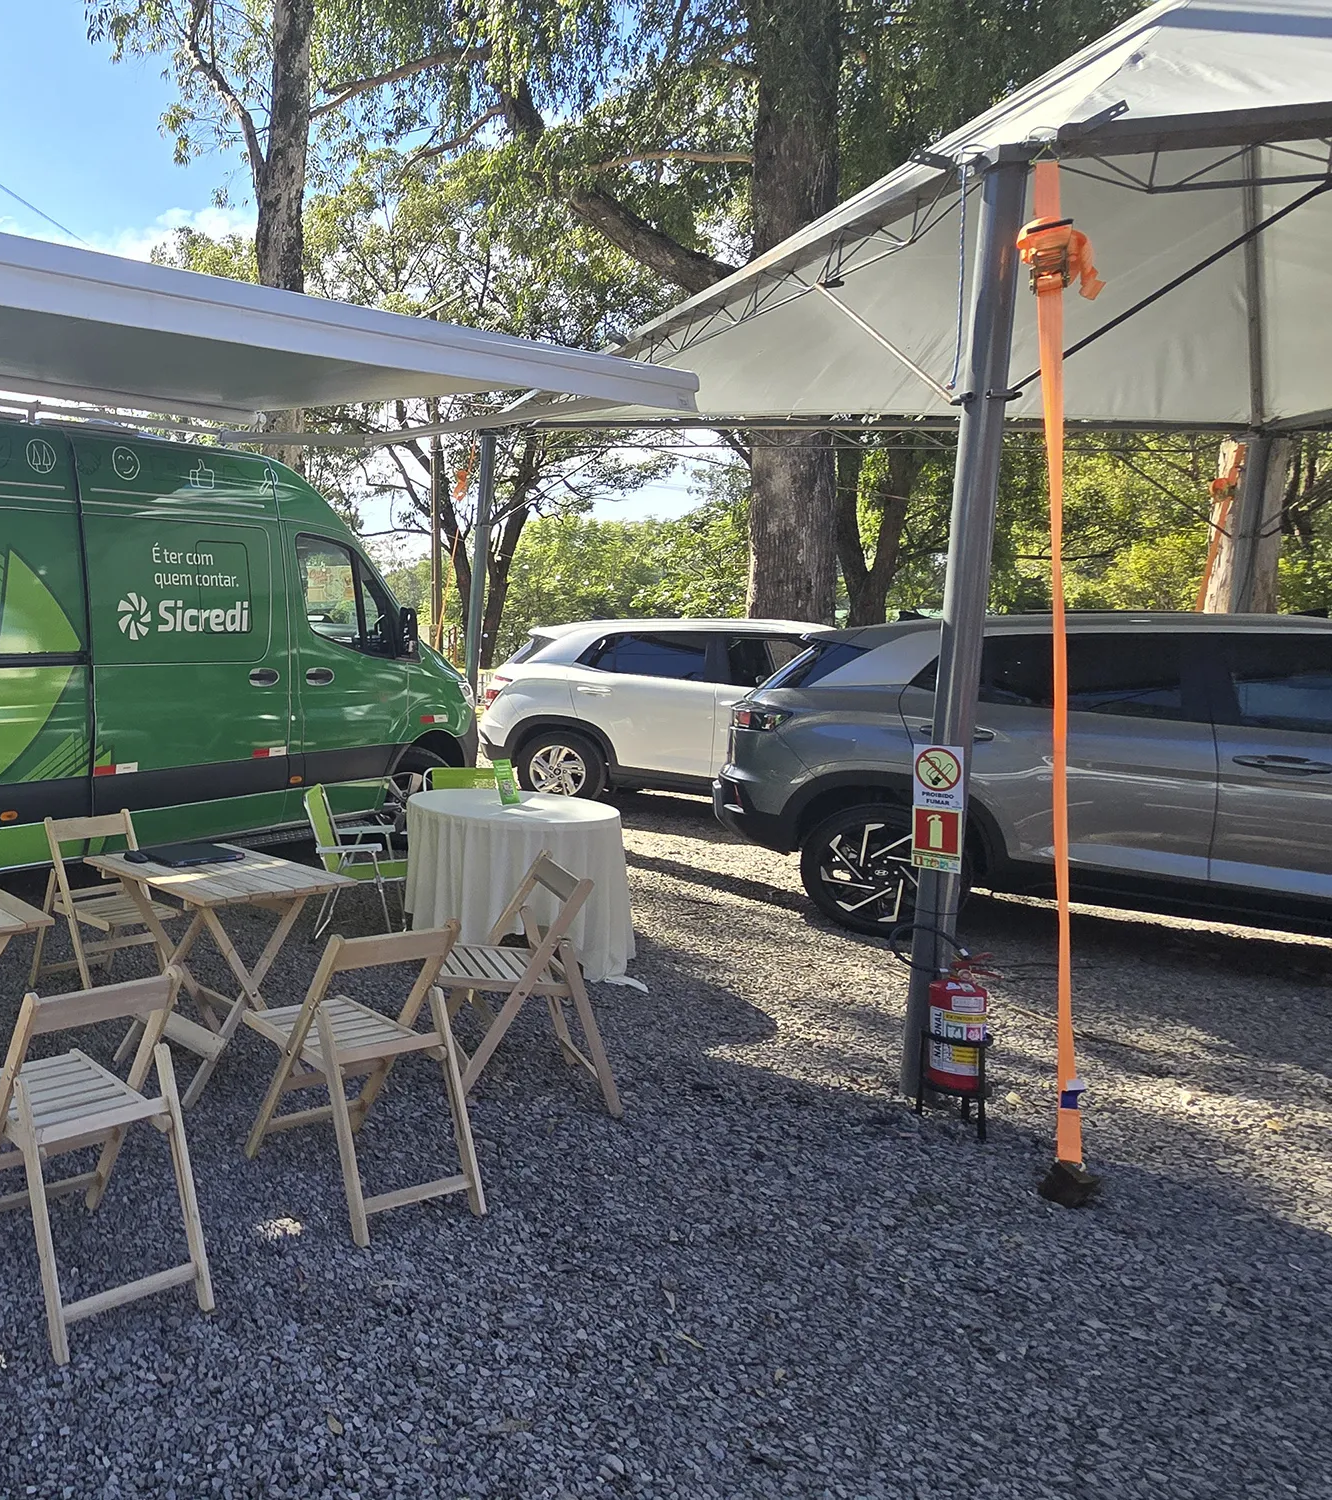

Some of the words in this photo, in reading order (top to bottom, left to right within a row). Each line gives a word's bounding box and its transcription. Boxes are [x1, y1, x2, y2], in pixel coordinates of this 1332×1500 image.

[152, 543, 163, 564] É
[163, 548, 183, 565] ter
[186, 551, 214, 566] com
[154, 572, 193, 589] quem
[196, 572, 240, 588] contar.
[157, 600, 249, 632] Sicredi
[922, 791, 955, 800] PROIBIDO
[926, 798, 950, 806] FUMAR
[934, 1012, 942, 1058] NACONAL
